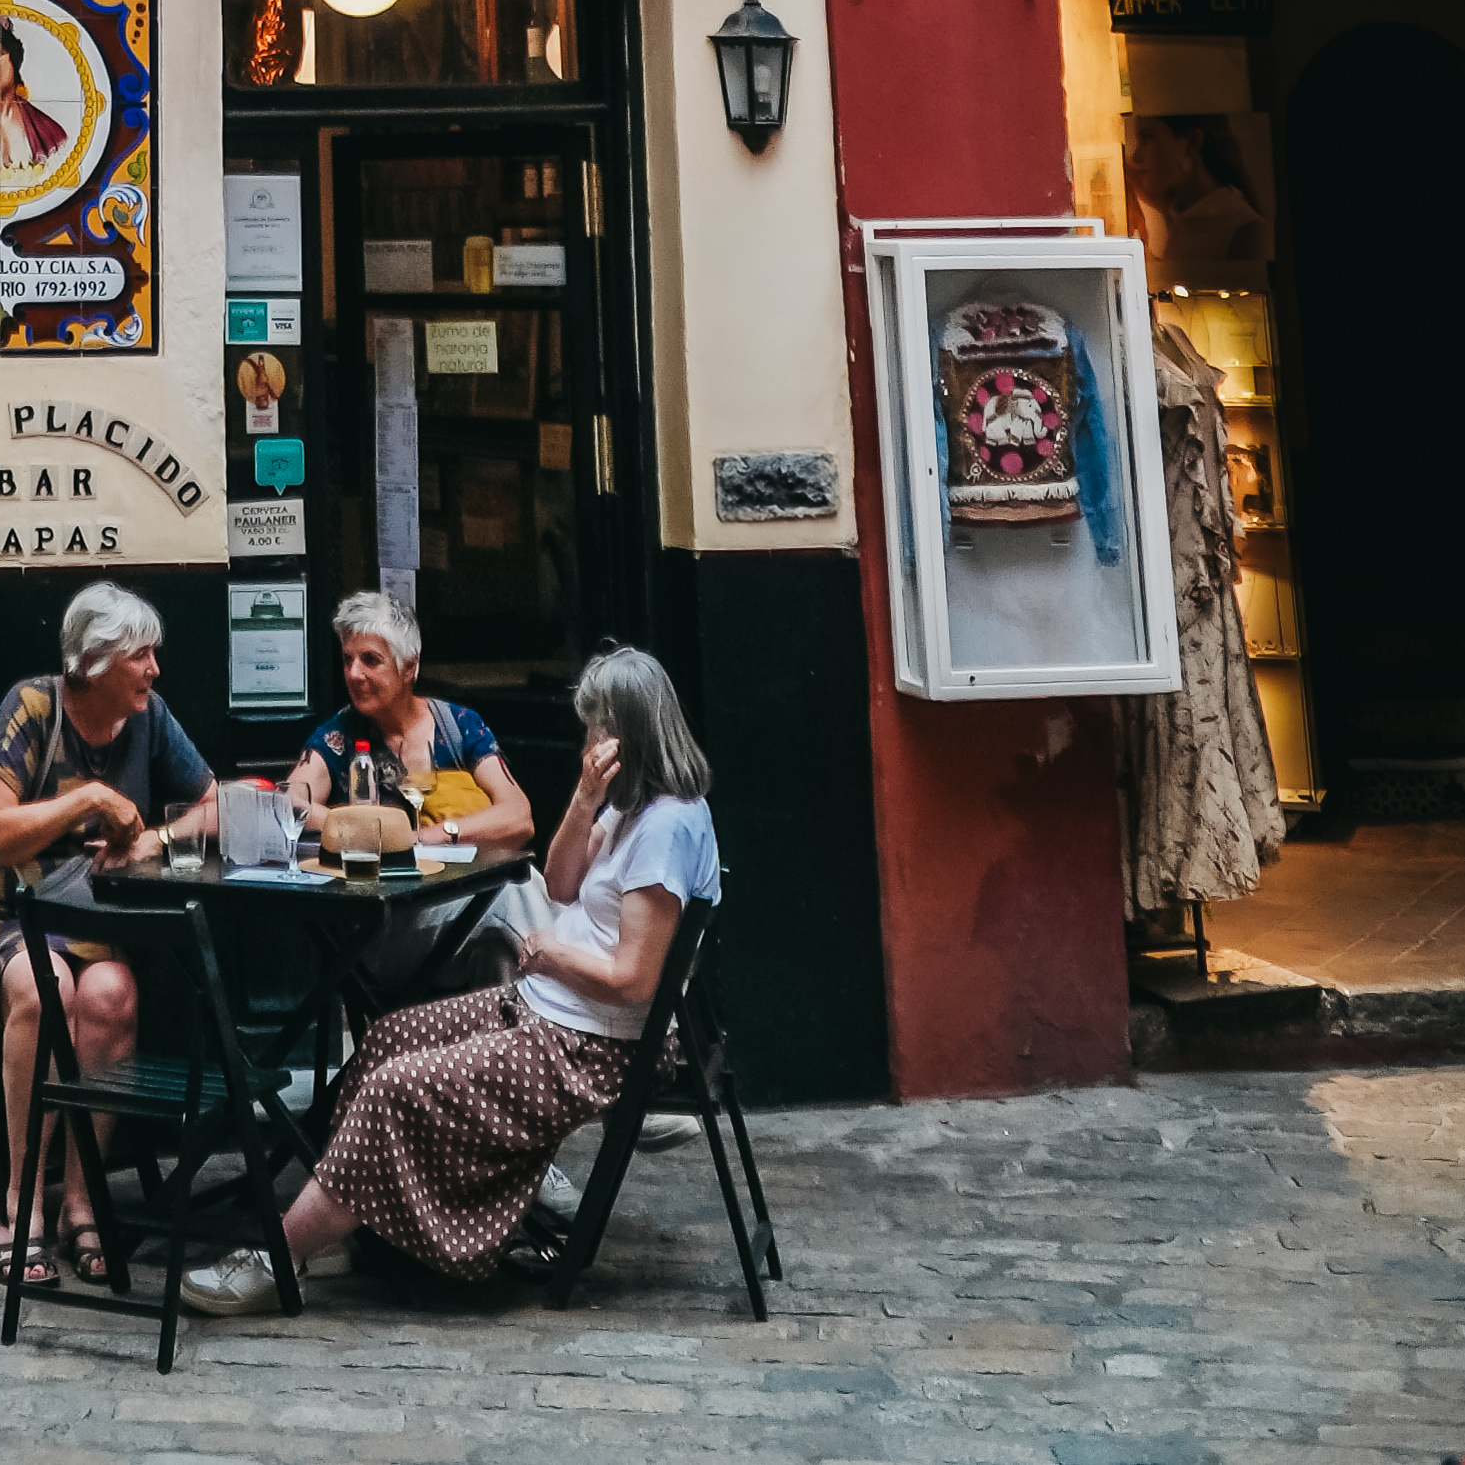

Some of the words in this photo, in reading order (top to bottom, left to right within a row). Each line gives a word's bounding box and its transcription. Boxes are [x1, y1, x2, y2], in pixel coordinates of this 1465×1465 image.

[35, 260, 45, 274] Y
[87, 260, 116, 275] S.A.
[35, 280, 107, 297] 1792-1992
[473, 325, 491, 338] de
[14, 405, 202, 508] PLACIDO
[242, 505, 288, 516] CERVEZA
[234, 515, 296, 527] PAULANER
